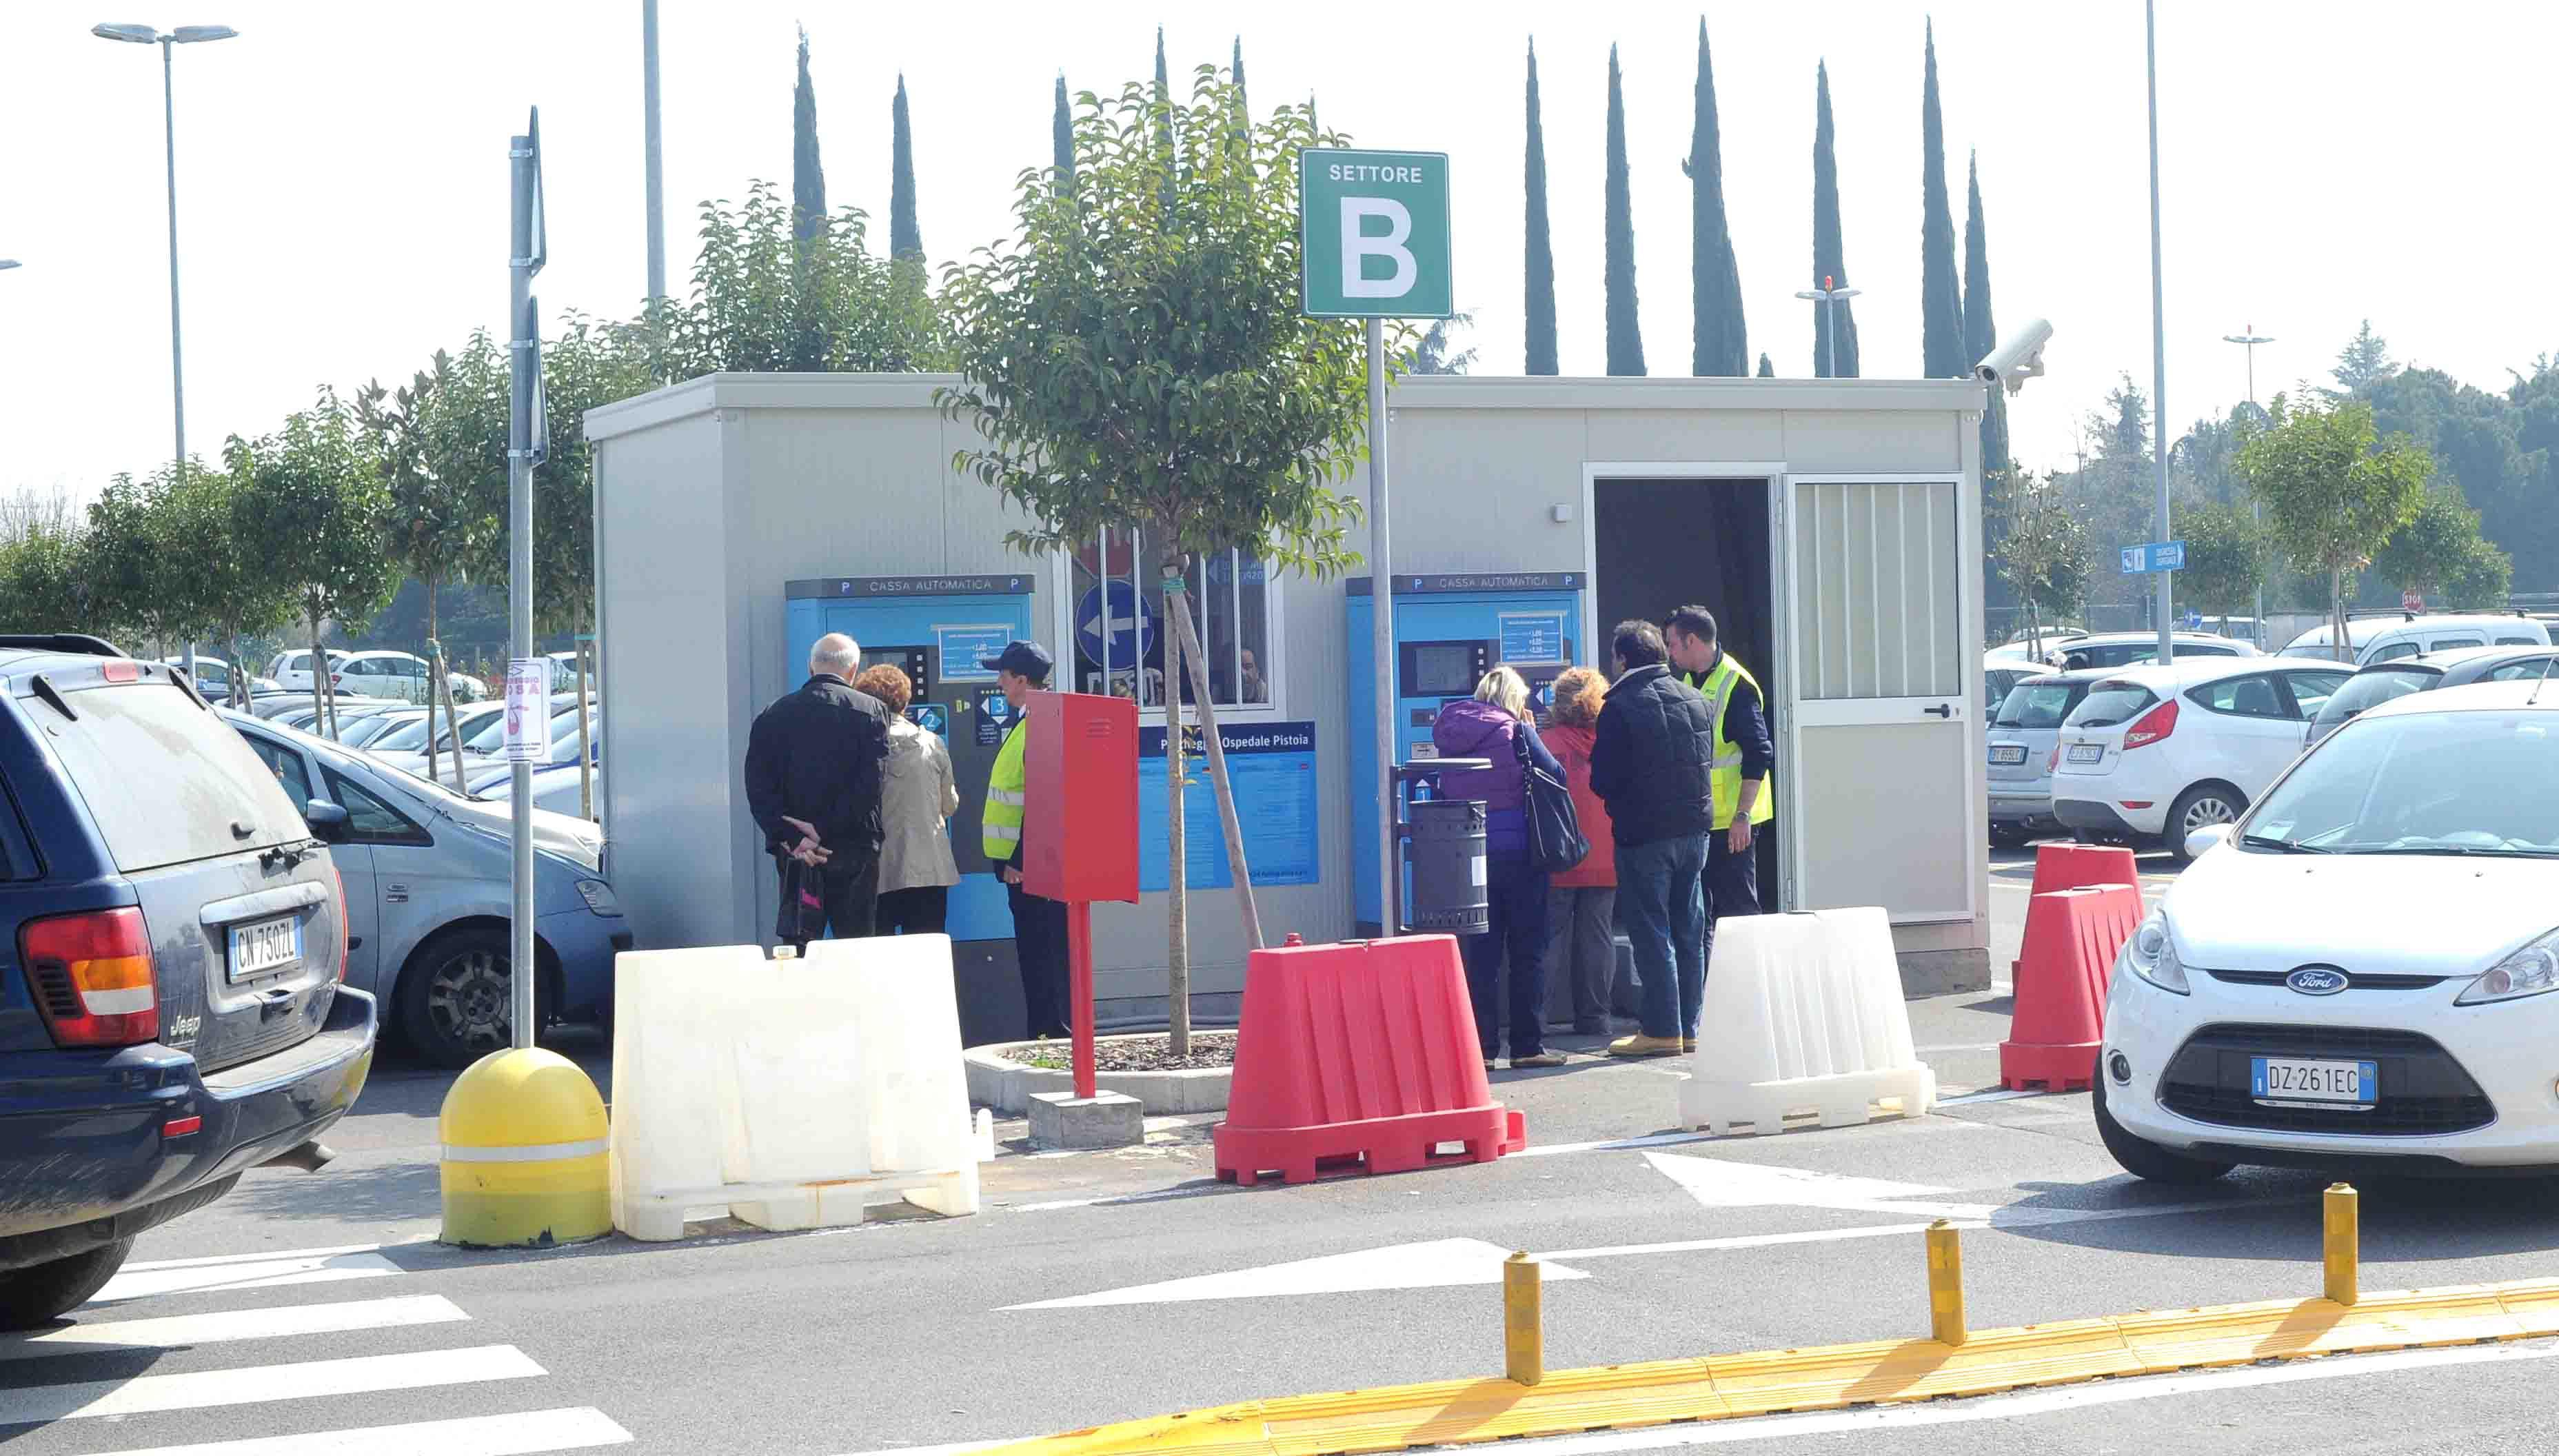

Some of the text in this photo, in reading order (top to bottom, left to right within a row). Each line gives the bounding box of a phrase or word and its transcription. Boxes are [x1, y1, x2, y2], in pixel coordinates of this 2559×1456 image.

[1330, 165, 1422, 182] SETTORE
[1340, 196, 1417, 298] B
[841, 578, 1019, 593] P CASSA AUTOMATICA P
[1415, 575, 1573, 588] P CASSA AUTOMATICA P
[995, 697, 1004, 713] 3
[927, 713, 935, 729] 2
[1222, 735, 1271, 749] Ospedale
[1273, 734, 1308, 746] Pistoia
[238, 922, 294, 967] CN 750ZL
[2298, 972, 2334, 988] Ford
[170, 1015, 201, 1036] Jeep
[2269, 1066, 2292, 1090] DZ
[2298, 1067, 2357, 1093] 261EC
